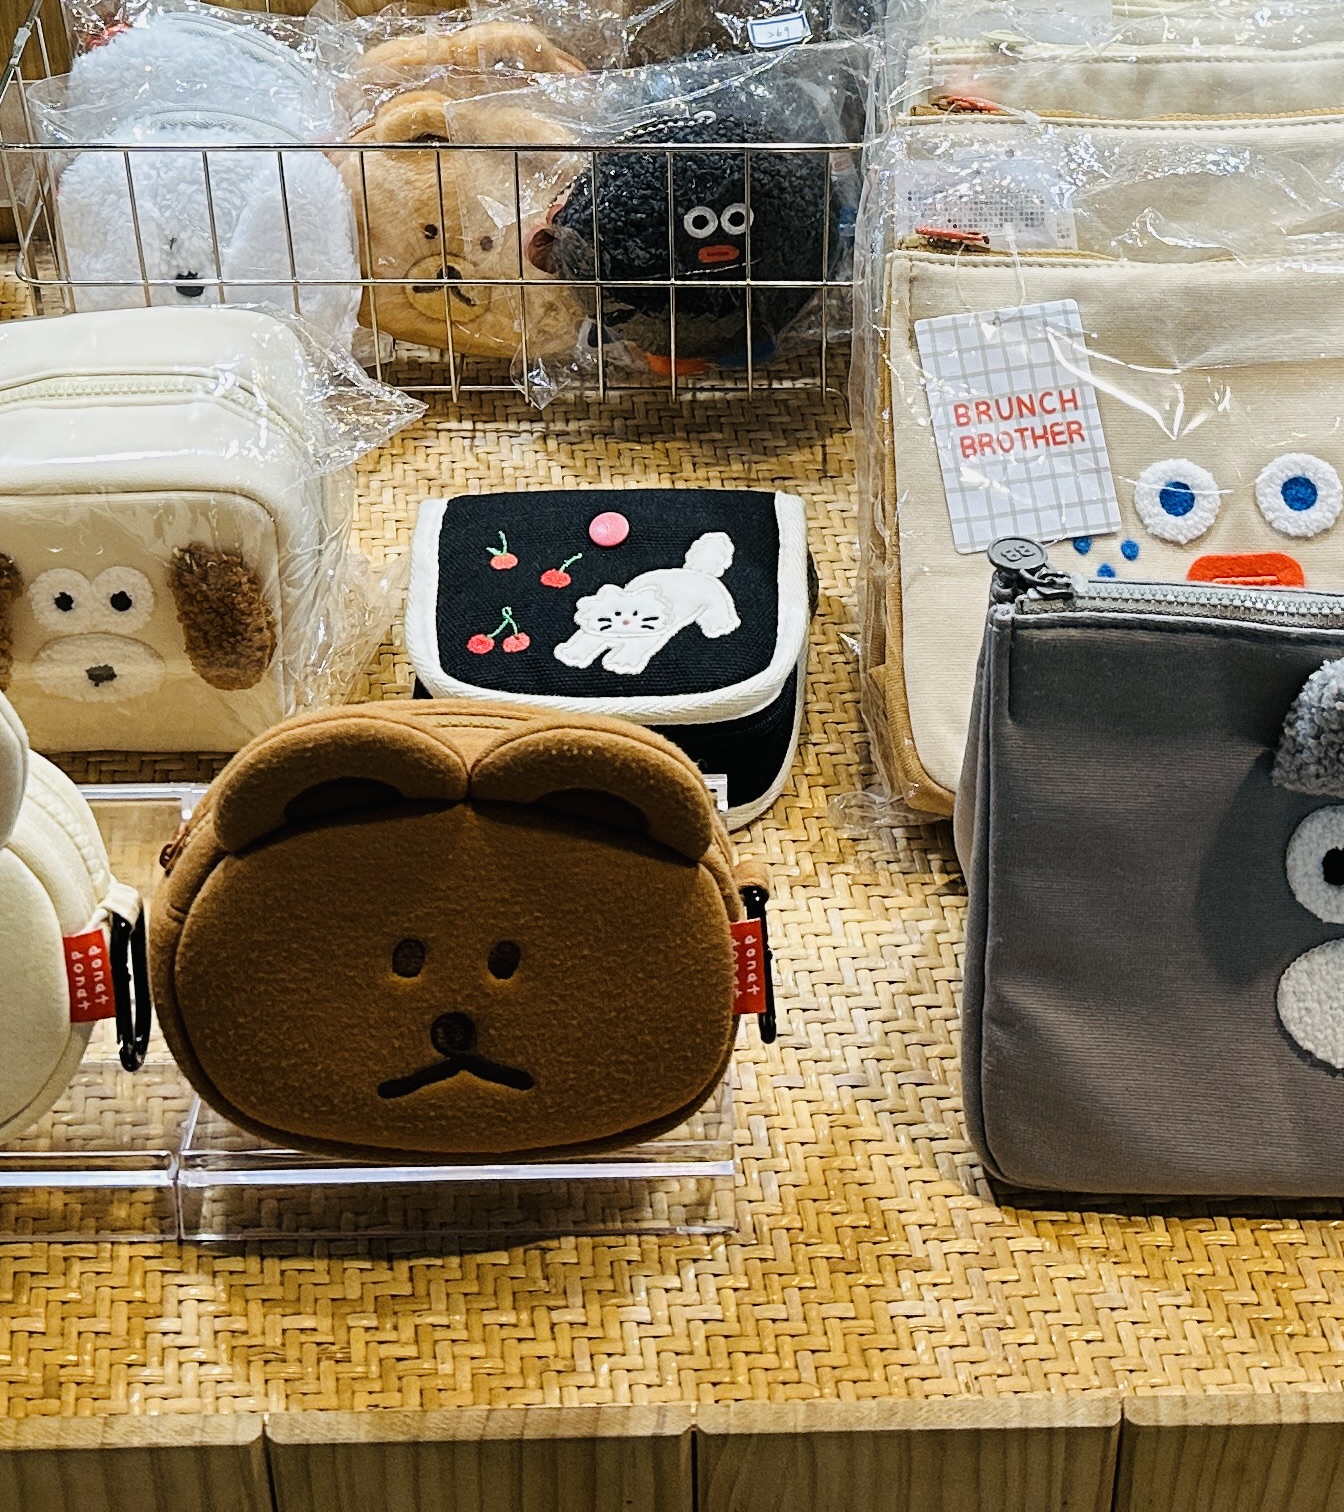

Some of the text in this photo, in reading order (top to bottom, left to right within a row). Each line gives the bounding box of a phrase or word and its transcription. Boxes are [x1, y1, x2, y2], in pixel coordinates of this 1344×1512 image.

[953, 388, 1079, 428] BRUNCH
[959, 420, 1086, 460] BROTHER
[70, 951, 92, 1010] donat
[88, 945, 110, 1005] donat
[744, 934, 761, 995] donat
